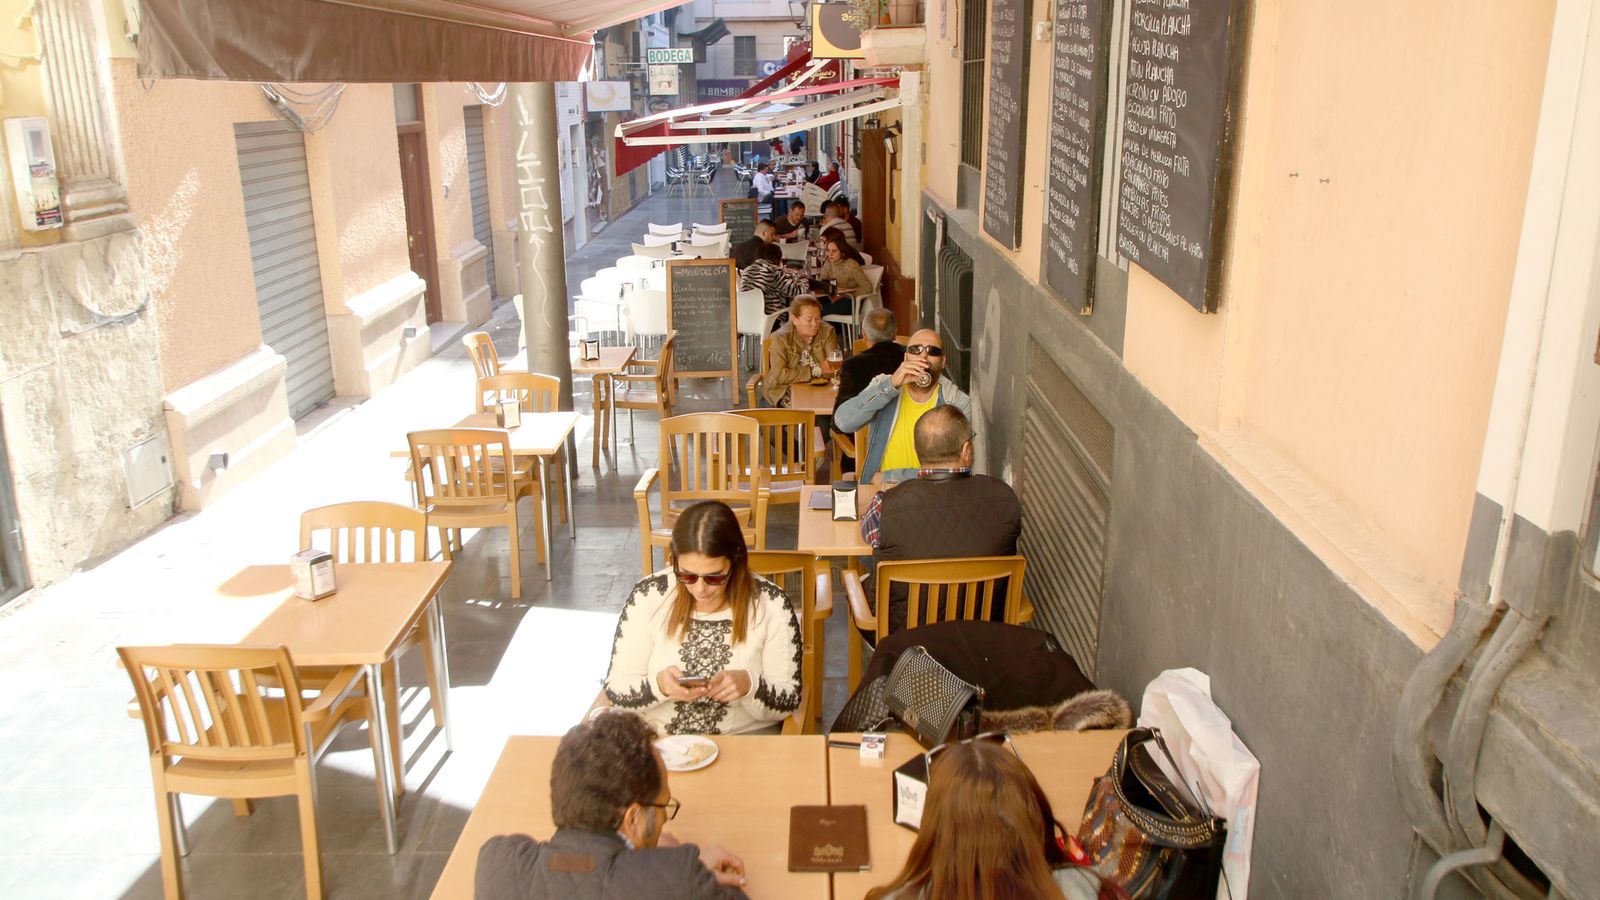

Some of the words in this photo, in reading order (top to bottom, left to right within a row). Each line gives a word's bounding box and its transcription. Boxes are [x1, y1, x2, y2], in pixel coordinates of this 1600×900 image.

[1134, 12, 1160, 33] MORCILLA
[1160, 14, 1191, 36] PLANCHA
[649, 50, 692, 63] BODEGA
[1152, 39, 1179, 61] PLANCHA
[1145, 60, 1174, 85] PLANCHA
[1149, 89, 1160, 102] EN
[1162, 85, 1187, 108] ADOBO
[1159, 104, 1177, 129] FRITO
[1152, 169, 1169, 189] FRITO
